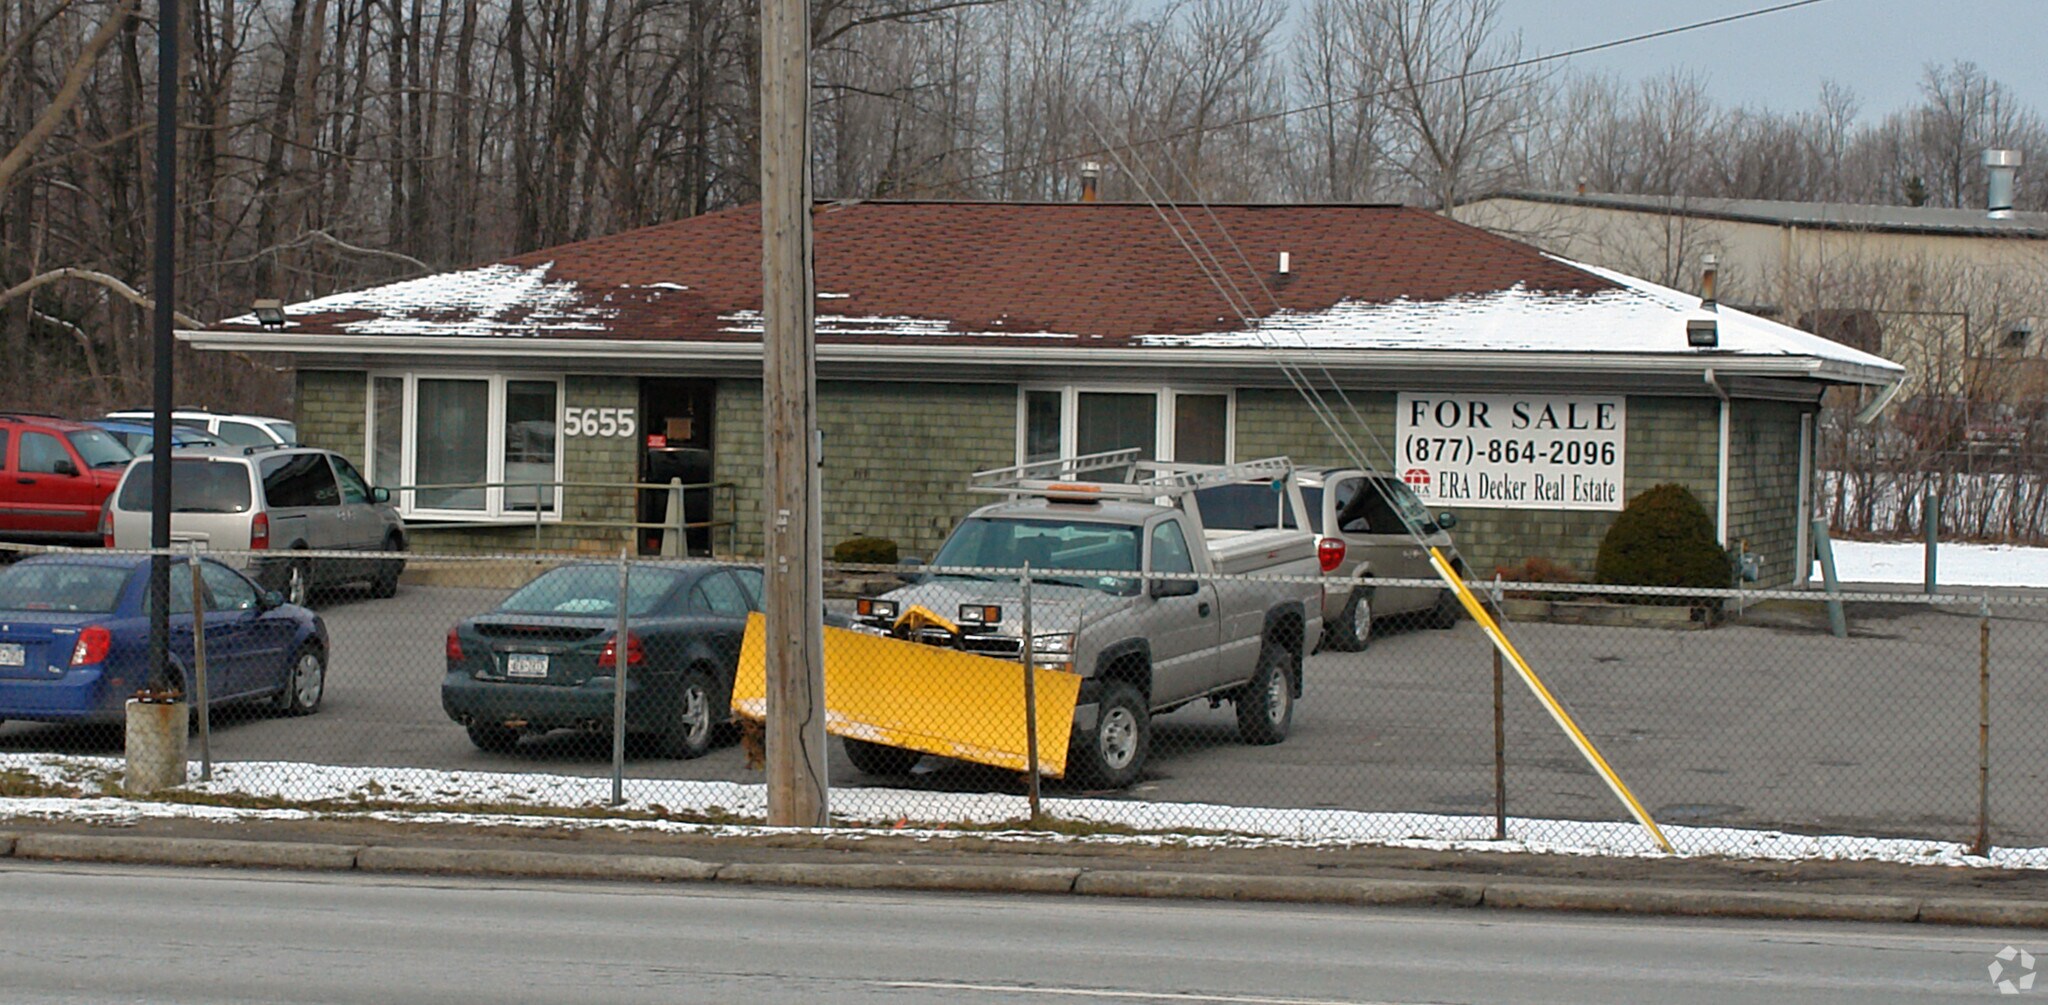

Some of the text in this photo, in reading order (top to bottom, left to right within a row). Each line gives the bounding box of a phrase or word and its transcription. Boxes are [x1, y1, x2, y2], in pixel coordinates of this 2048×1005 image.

[564, 407, 635, 437] 5655
[1409, 400, 1616, 430] FOR SALE
[1405, 434, 1616, 465] (877)-864-2096
[1439, 471, 1616, 503] ERA Decker Real Estate
